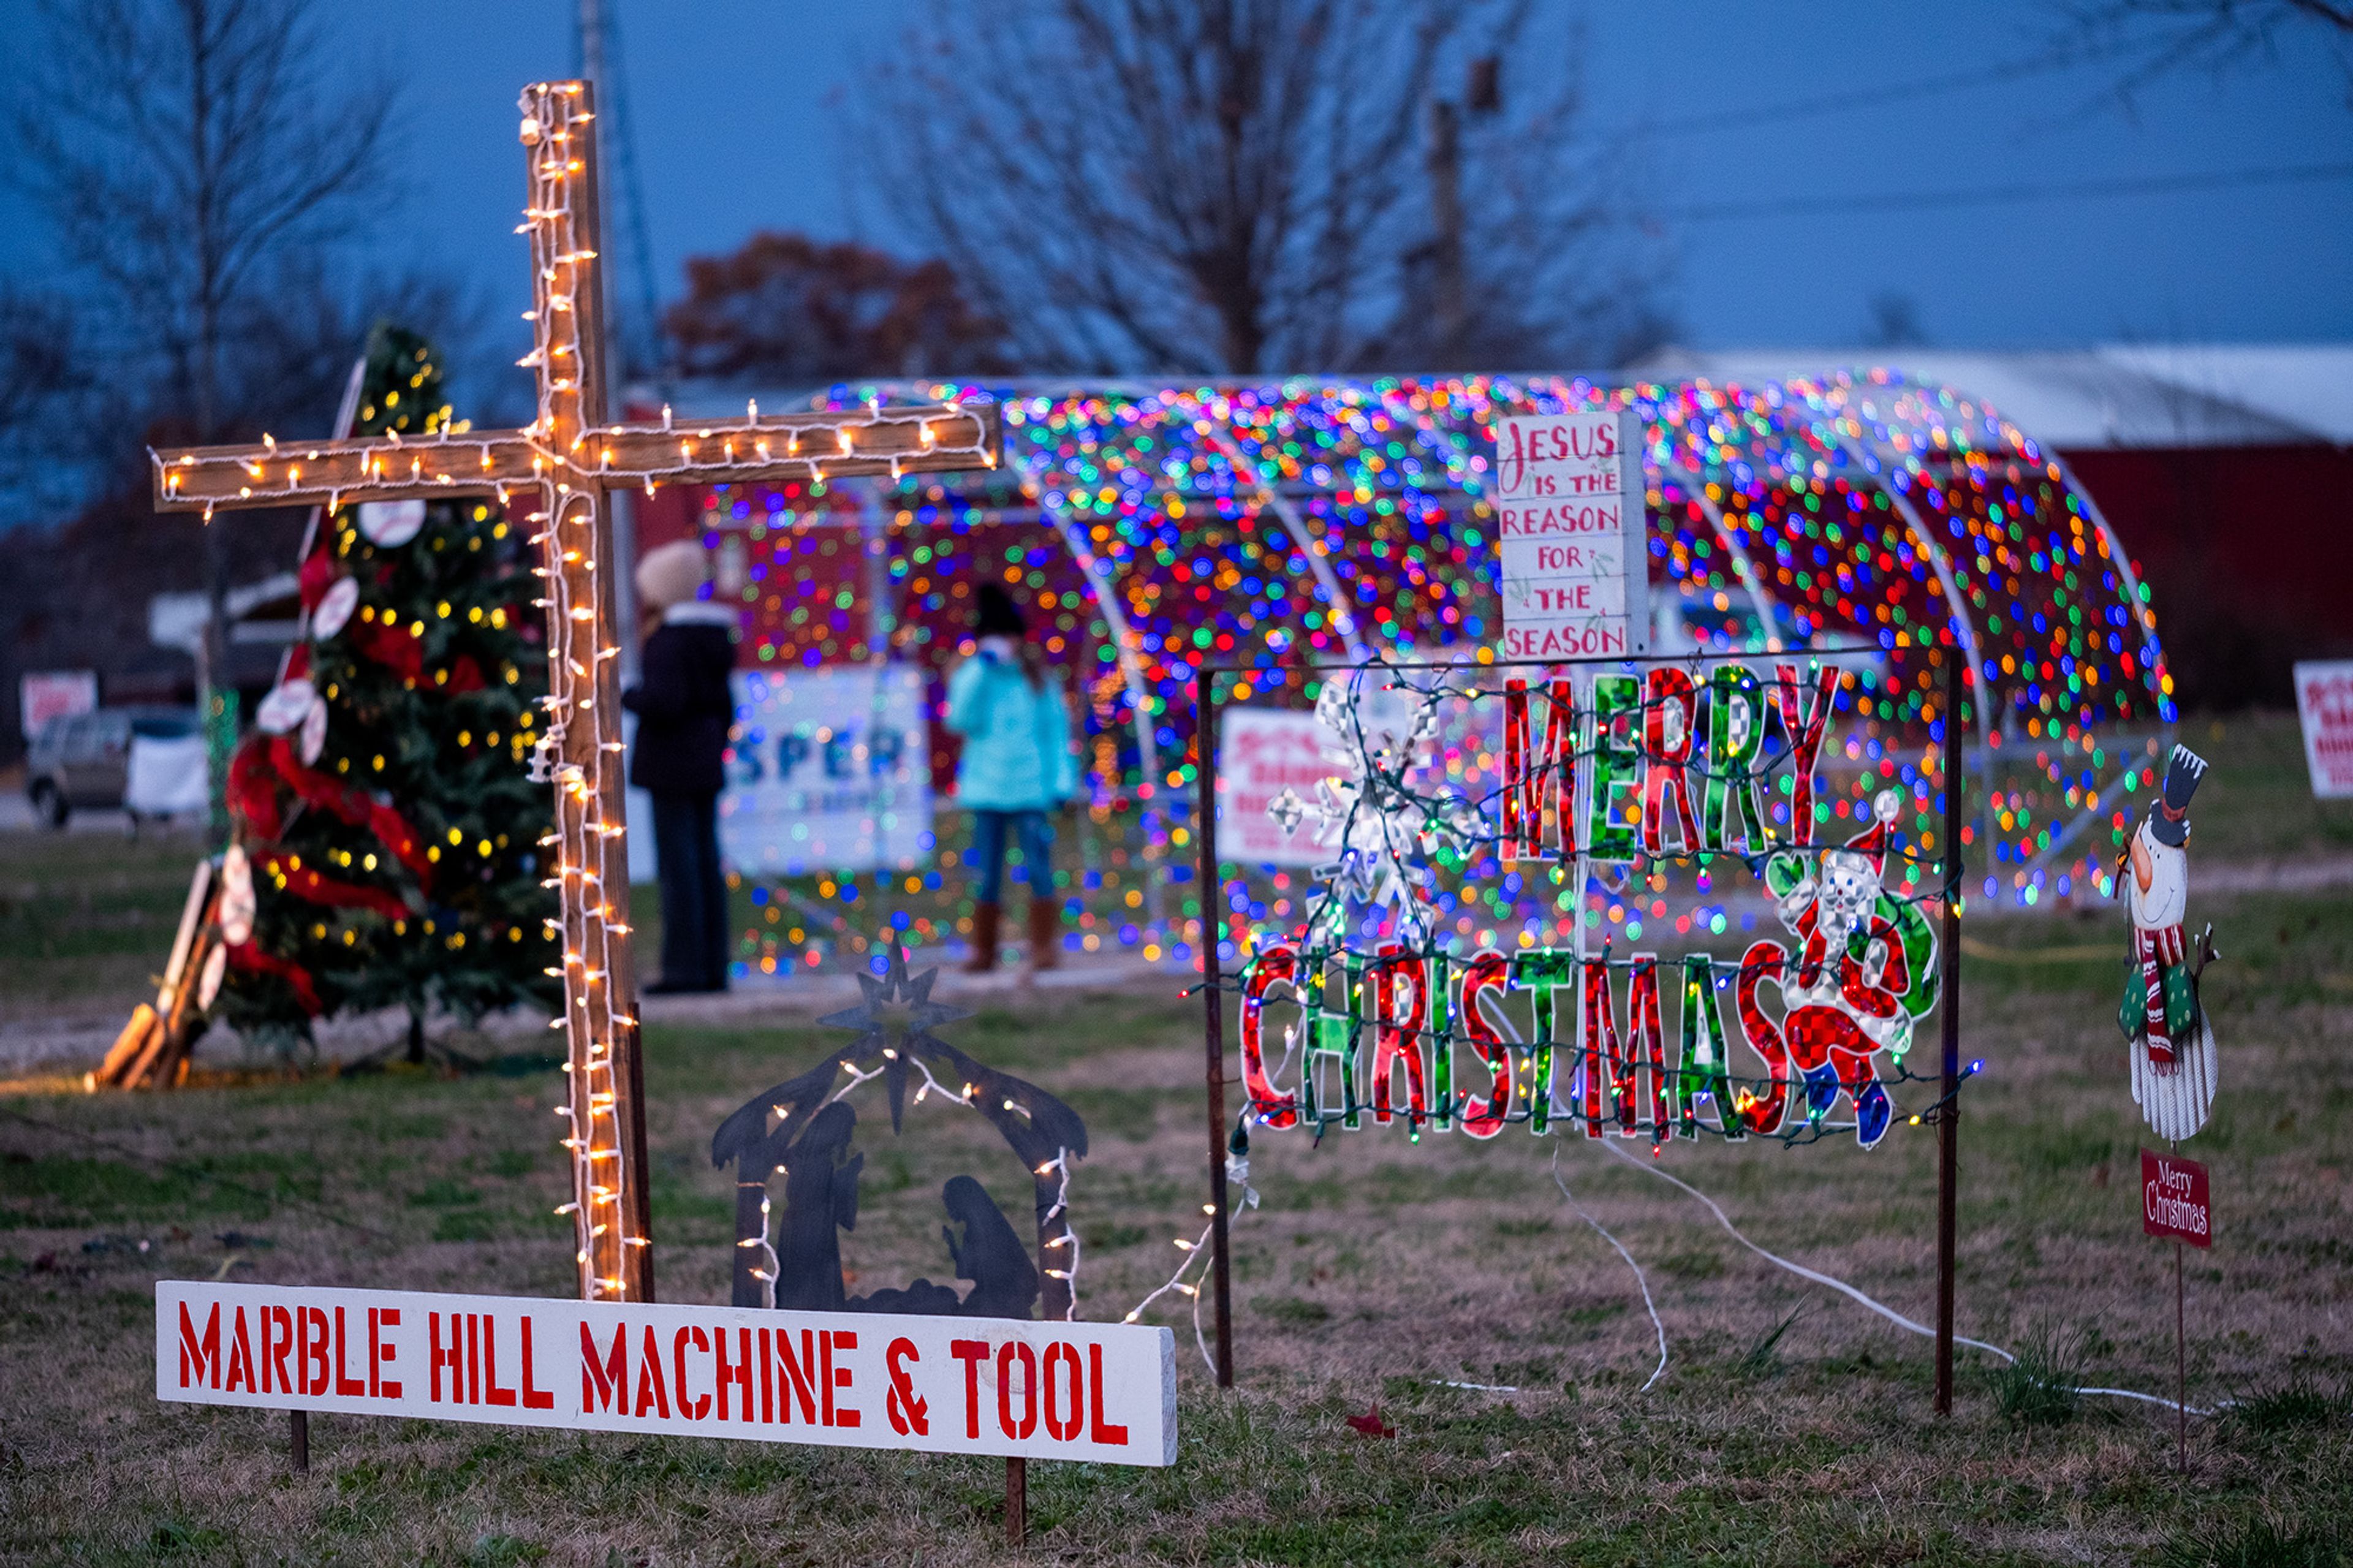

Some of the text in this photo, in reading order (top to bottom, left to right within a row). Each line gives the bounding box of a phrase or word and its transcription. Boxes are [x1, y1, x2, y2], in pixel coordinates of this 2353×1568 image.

[1501, 422, 1615, 494] JESUS
[1534, 472, 1618, 496] IS THE
[1502, 503, 1618, 536] REASON
[1537, 545, 1583, 570] FOR
[1534, 585, 1591, 611] THE
[1506, 626, 1624, 657] SEASON
[1499, 664, 1840, 863] MERRY
[1240, 939, 1790, 1141] CHRISTMAS
[2158, 1160, 2192, 1199] Merry
[2146, 1180, 2207, 1235] Christmas
[179, 1300, 1129, 1445] MARBLE HILL MACHINE & TOOL
